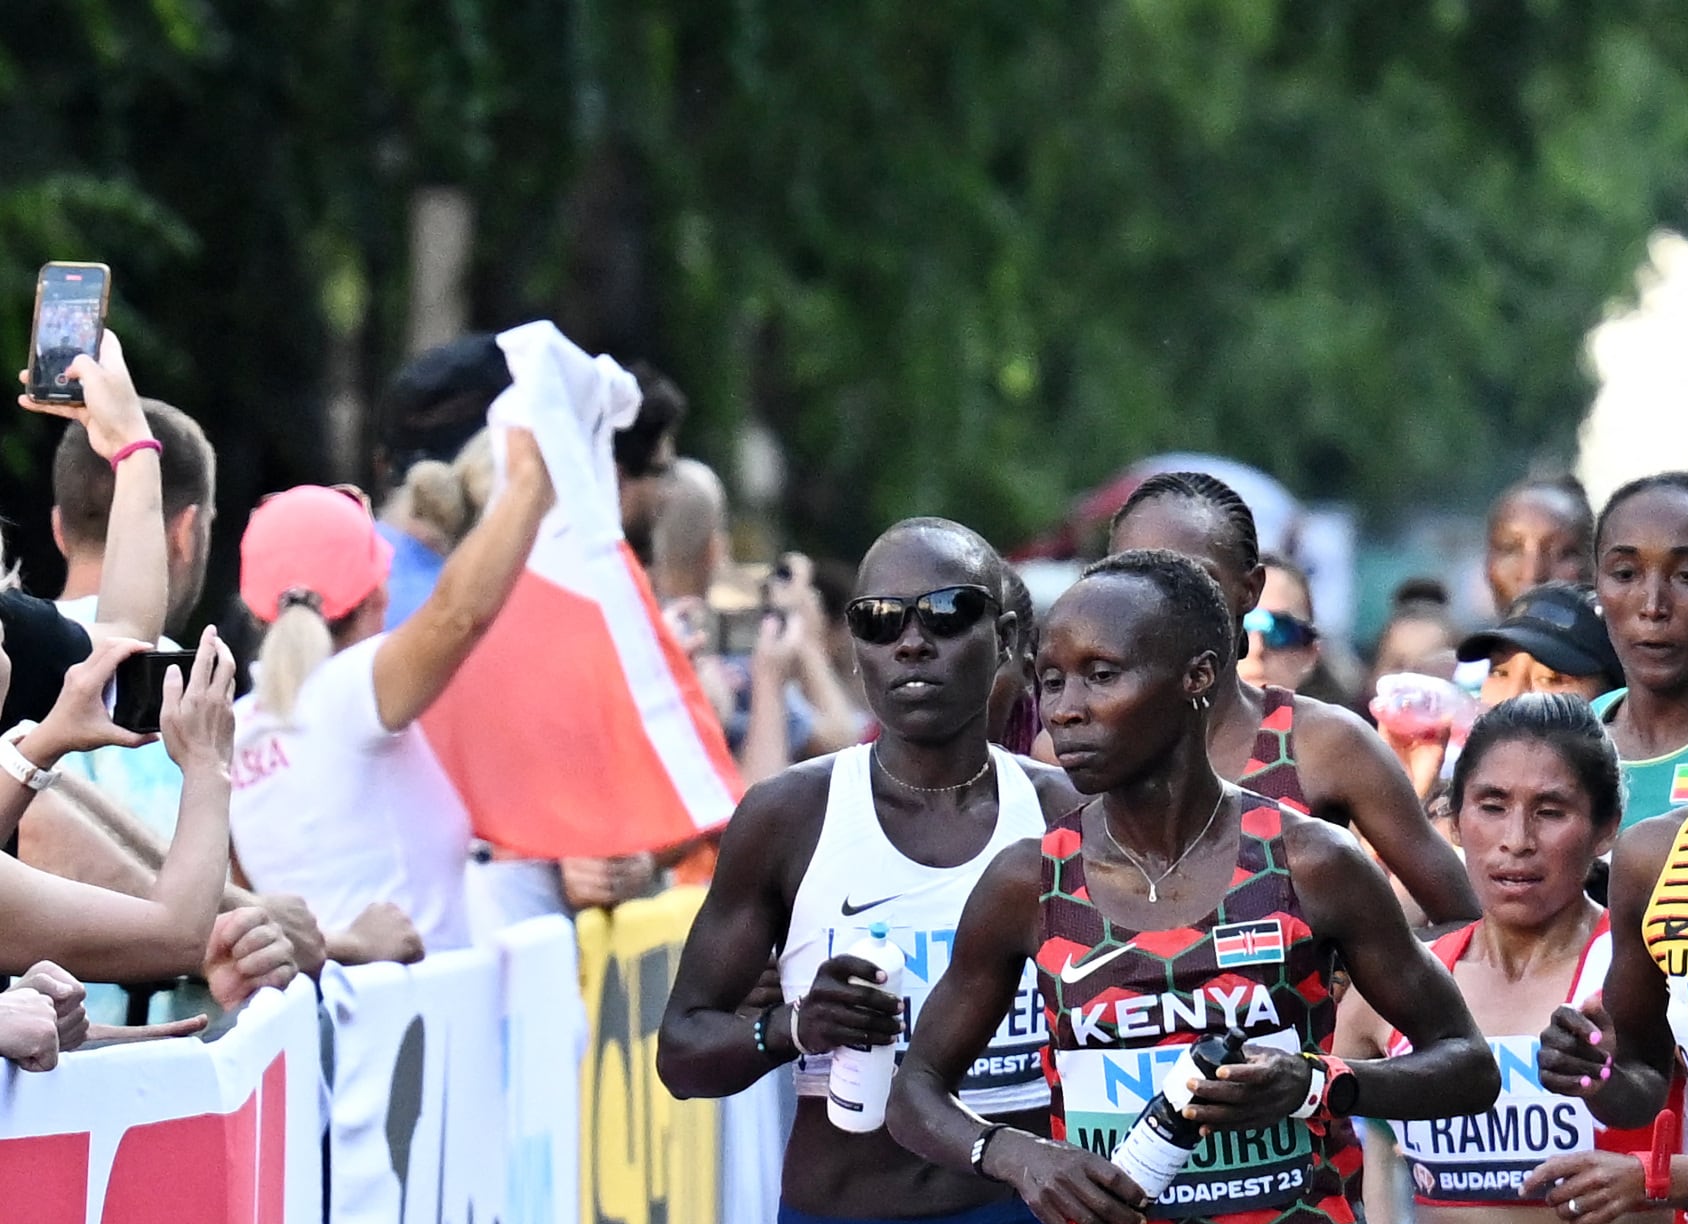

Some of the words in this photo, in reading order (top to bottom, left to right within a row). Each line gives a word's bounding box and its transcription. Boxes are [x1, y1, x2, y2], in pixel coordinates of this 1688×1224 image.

[1070, 984, 1280, 1046] KENYA
[967, 1053, 1029, 1078] PEST
[1078, 1119, 1297, 1168] WJIRU
[1430, 1103, 1579, 1154] RAMOS
[1154, 1175, 1274, 1204] UDAPEST
[1277, 1168, 1303, 1190] 23
[1439, 1170, 1533, 1190] BUDAPE
